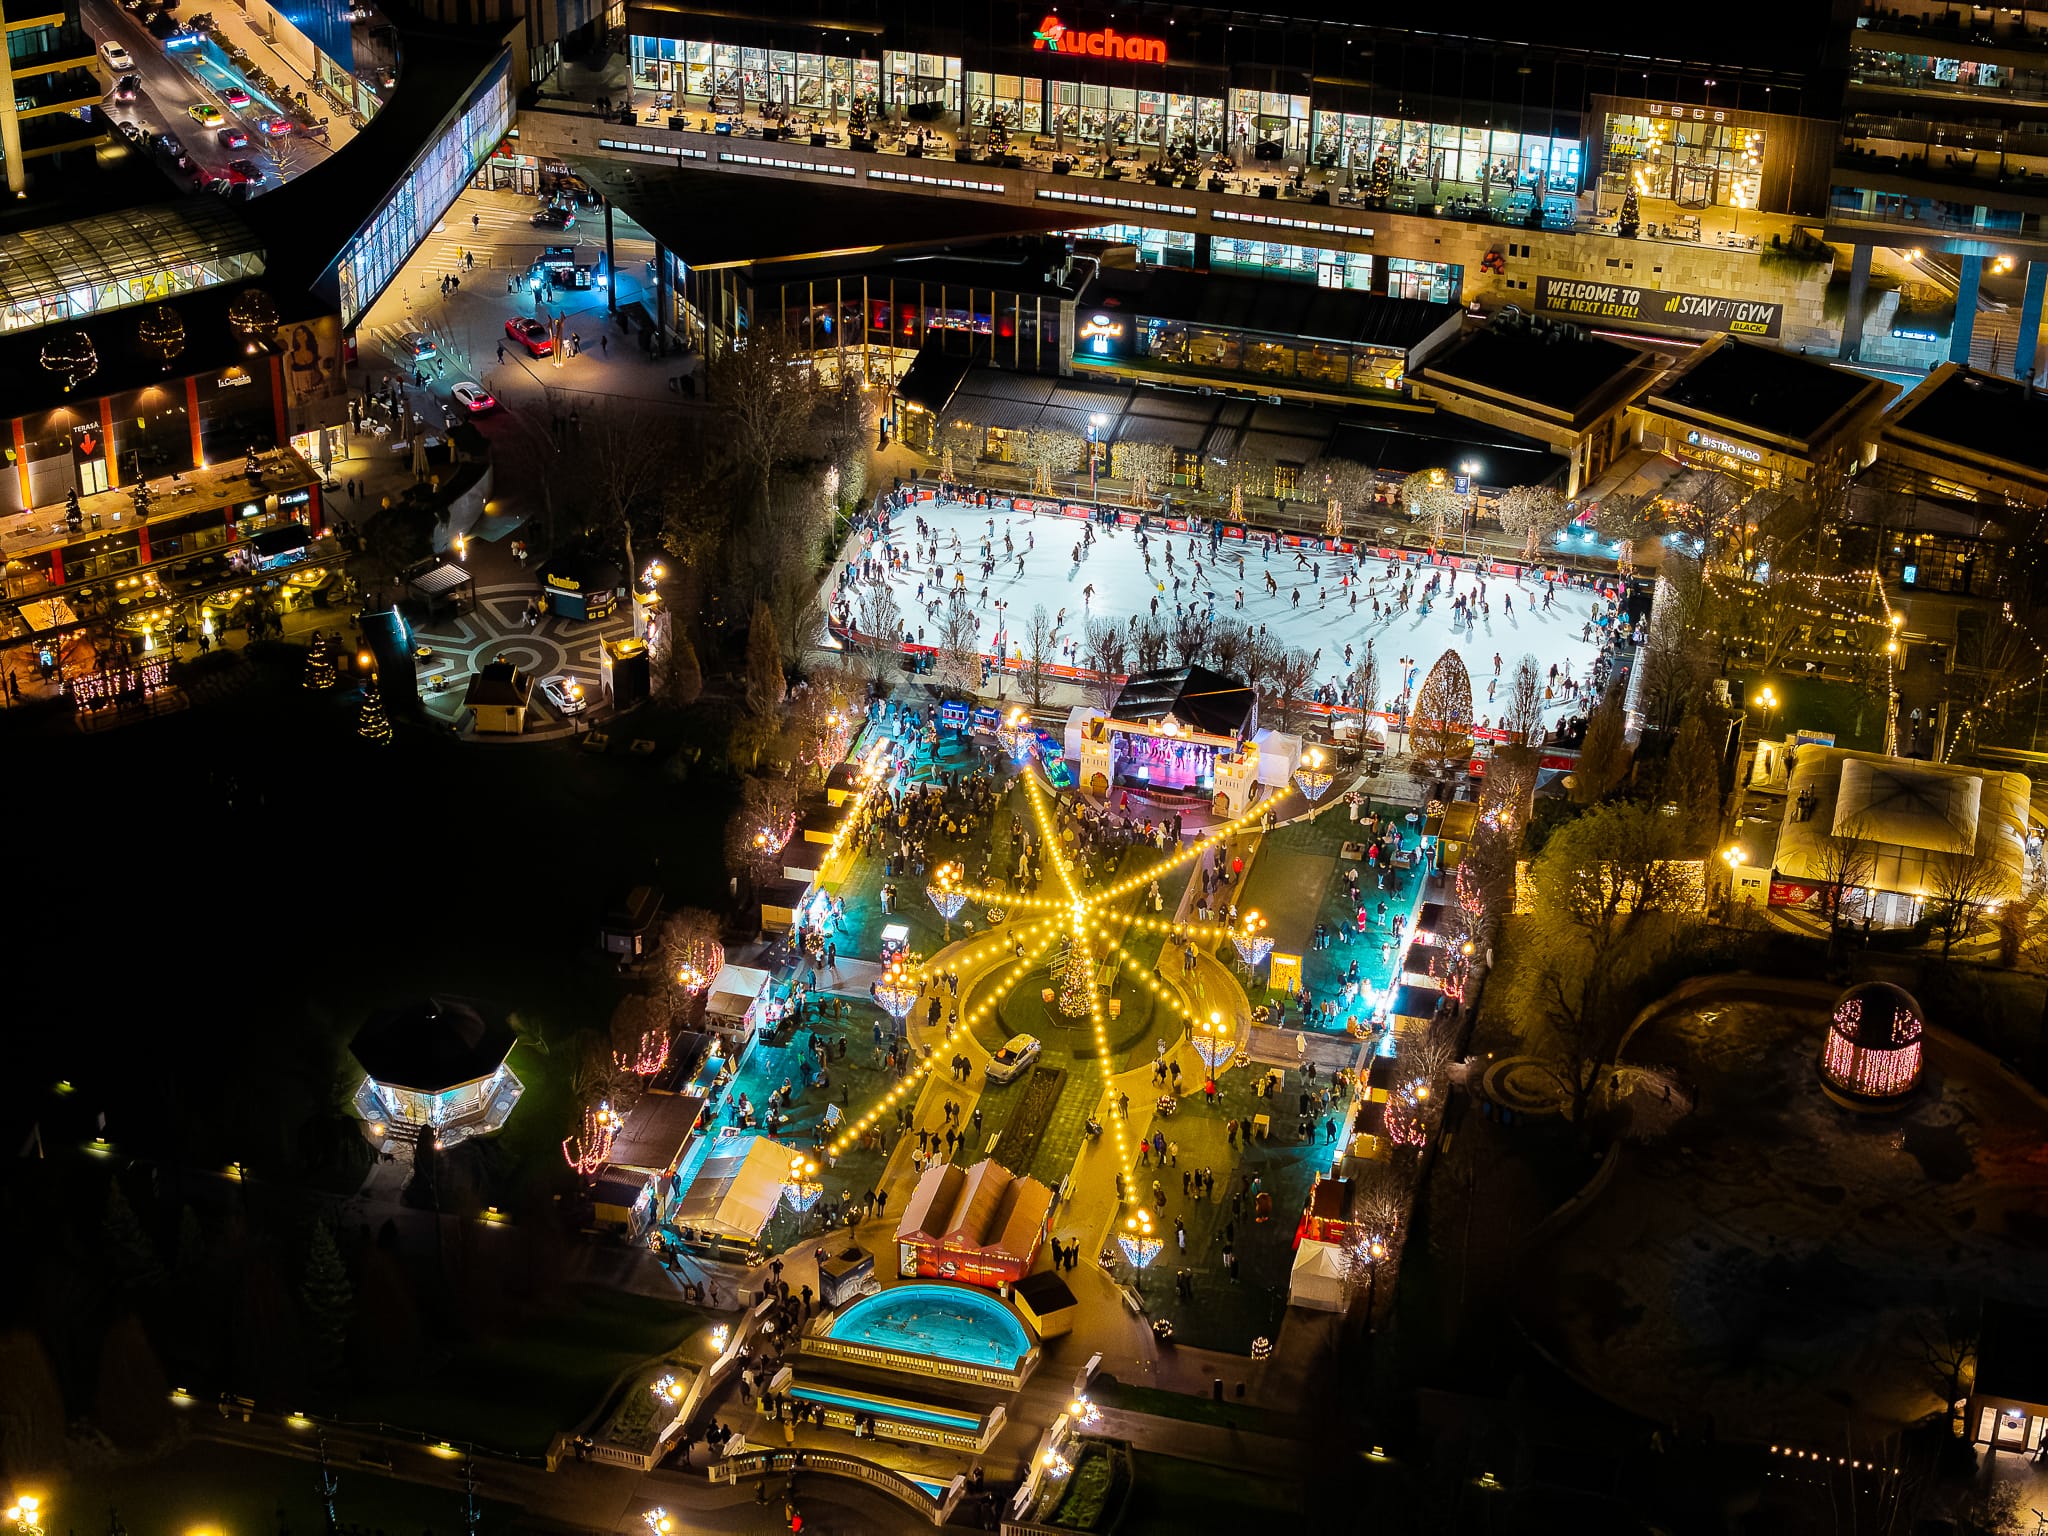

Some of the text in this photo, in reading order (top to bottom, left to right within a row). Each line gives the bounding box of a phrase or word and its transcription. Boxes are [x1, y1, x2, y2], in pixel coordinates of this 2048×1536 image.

[1033, 16, 1166, 63] Auchan
[1547, 280, 1640, 306] WELCOME TO
[1546, 296, 1639, 319] THE NEXT LEVEL!
[1679, 296, 1775, 324] STAYFITGYM
[1701, 434, 1760, 462] BISTRO MOO
